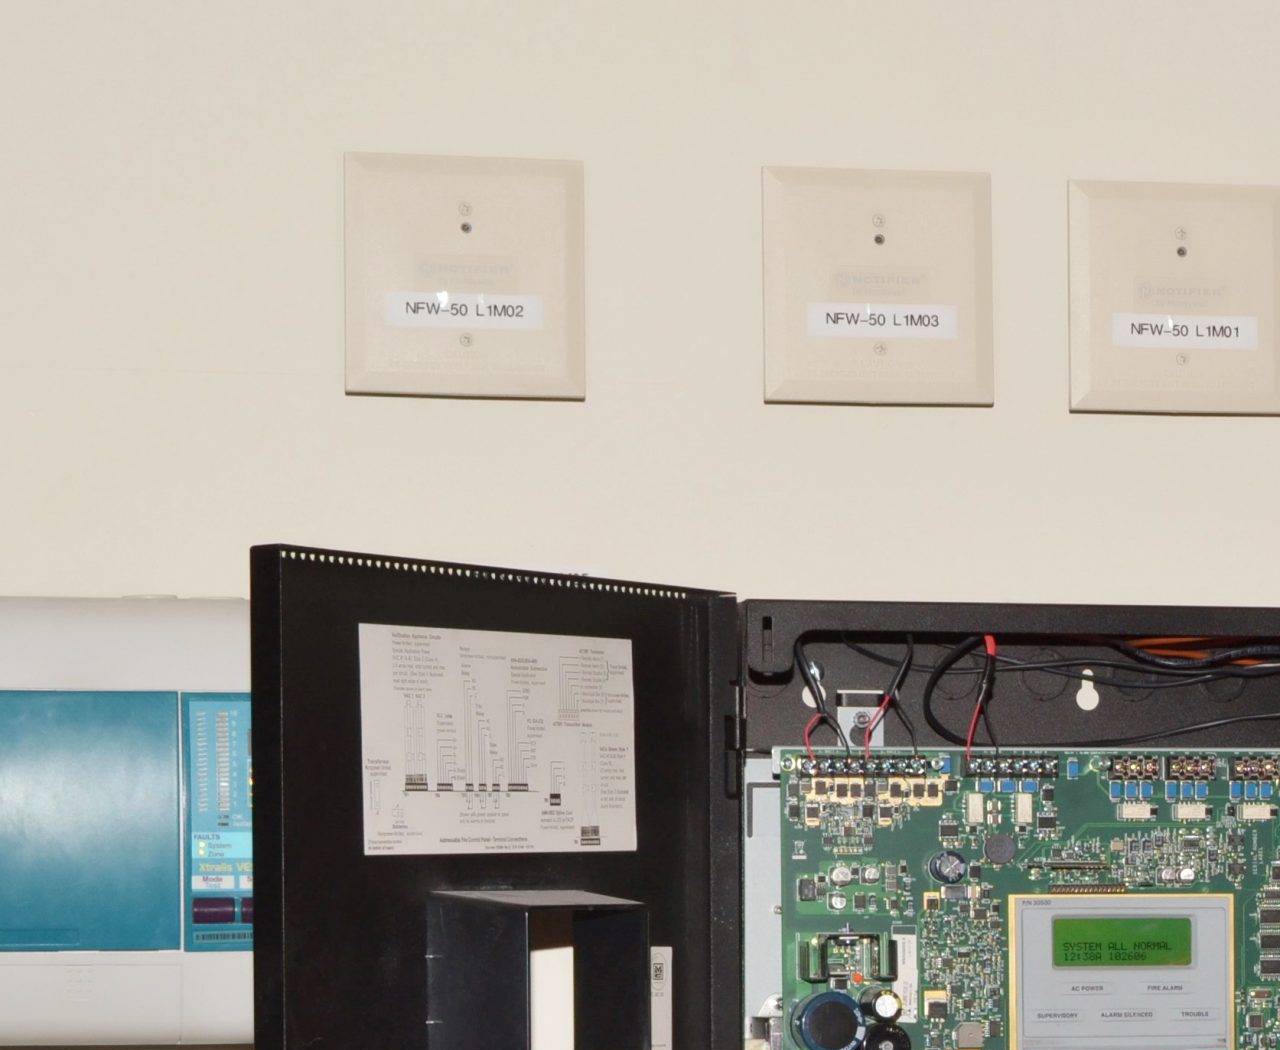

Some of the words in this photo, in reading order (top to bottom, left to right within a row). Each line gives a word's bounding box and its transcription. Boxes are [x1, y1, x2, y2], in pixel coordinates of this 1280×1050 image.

[405, 302, 468, 317] NFW-50
[476, 303, 524, 318] L1M02
[825, 311, 886, 327] NFW-50
[893, 313, 940, 328] L1M03
[1130, 322, 1189, 337] NFW-50
[1196, 324, 1240, 338] L1M01
[1063, 942, 1102, 951] SYSTEM
[1108, 942, 1128, 951] ALL
[1133, 941, 1172, 951] NORMAL
